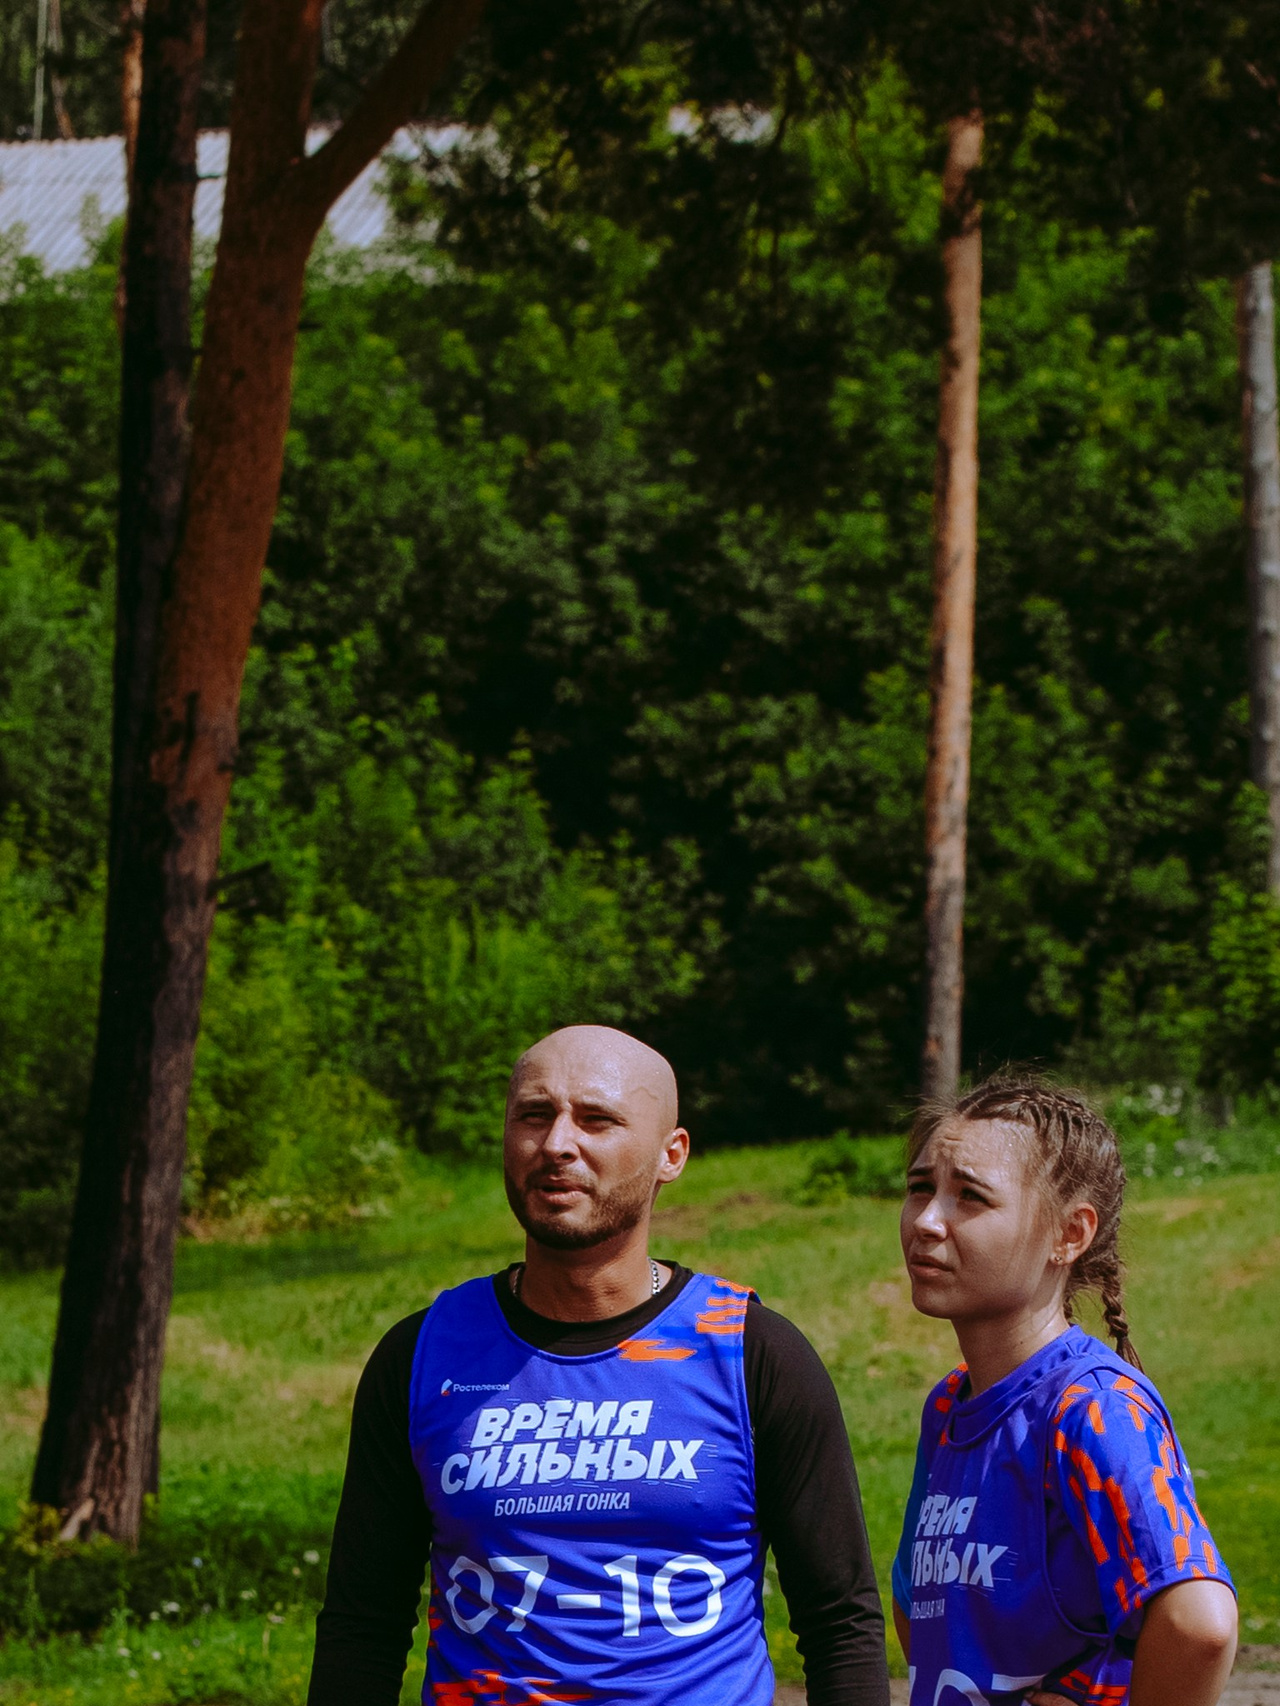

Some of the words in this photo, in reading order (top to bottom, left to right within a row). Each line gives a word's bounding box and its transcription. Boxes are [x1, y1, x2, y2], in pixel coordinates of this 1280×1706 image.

[453, 1383, 510, 1392] Ростелеком
[469, 1399, 654, 1448] ВРЕМЯ
[441, 1438, 705, 1494] СИЛЬНЫХ
[494, 1496, 574, 1517] БОЛЬШАЯ
[577, 1492, 631, 1511] ГОНКА
[914, 1494, 978, 1537] РЕМЯ
[445, 1554, 727, 1637] 07-10
